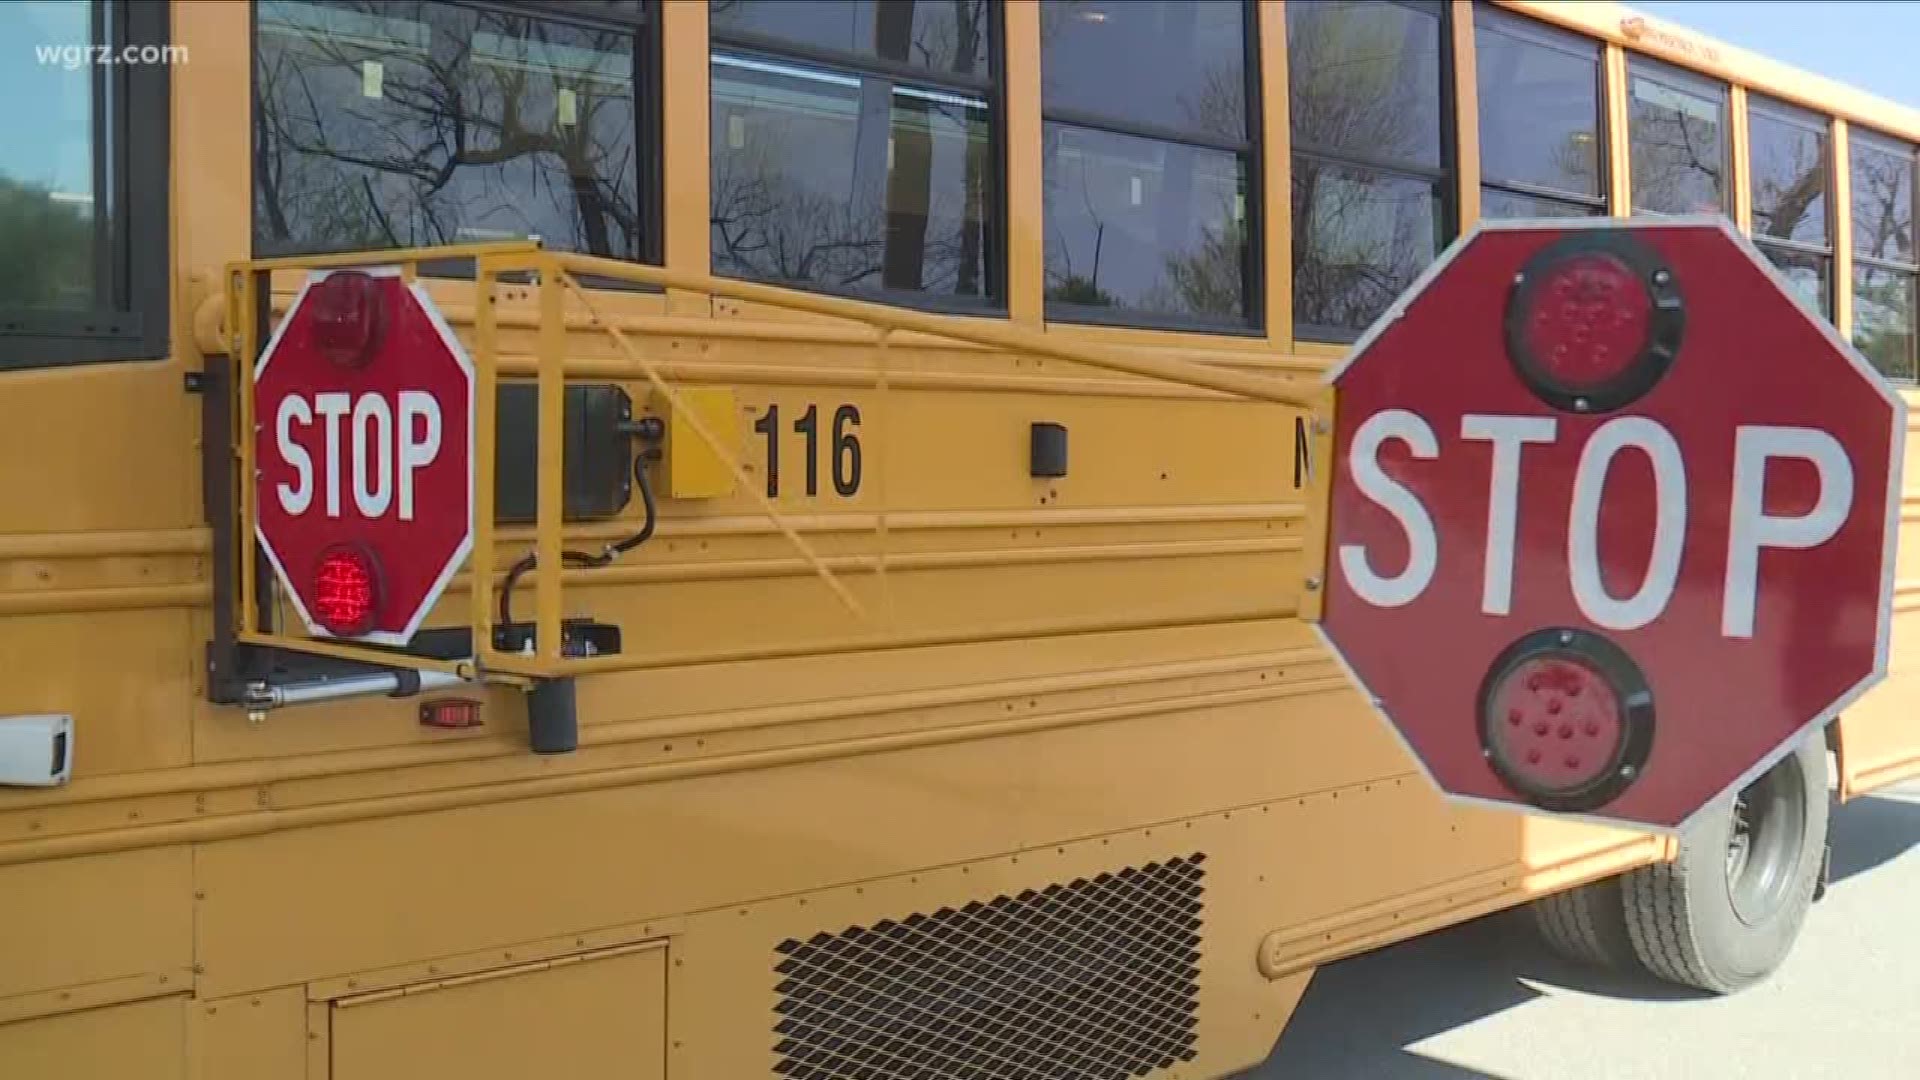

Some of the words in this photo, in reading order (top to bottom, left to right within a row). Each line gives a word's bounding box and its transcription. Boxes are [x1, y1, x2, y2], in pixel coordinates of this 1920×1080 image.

[276, 390, 442, 522] STOP
[754, 403, 862, 498] 116
[1339, 408, 1854, 638] STOP
